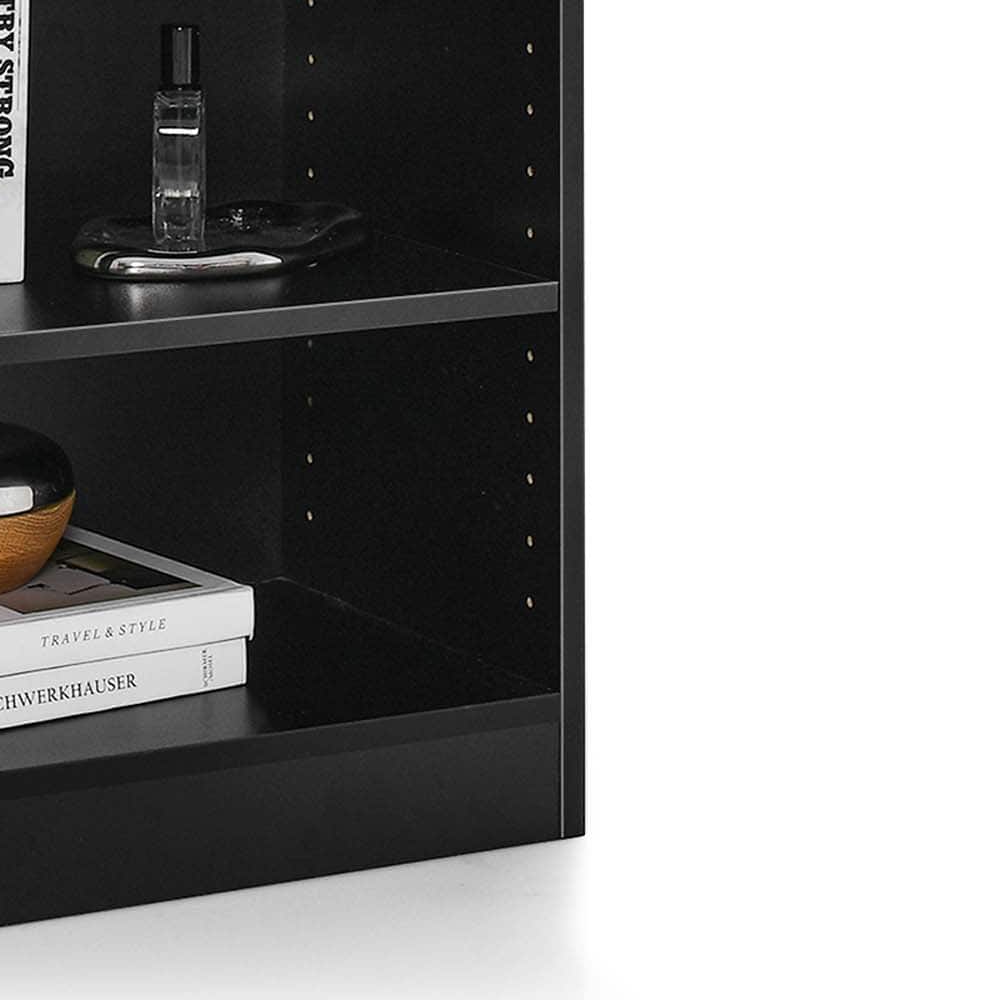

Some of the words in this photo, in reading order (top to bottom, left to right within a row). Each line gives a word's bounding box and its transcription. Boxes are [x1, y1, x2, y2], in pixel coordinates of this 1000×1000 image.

[40, 629, 100, 647] TRAVEL
[105, 626, 113, 638] &
[118, 618, 167, 636] STYLE
